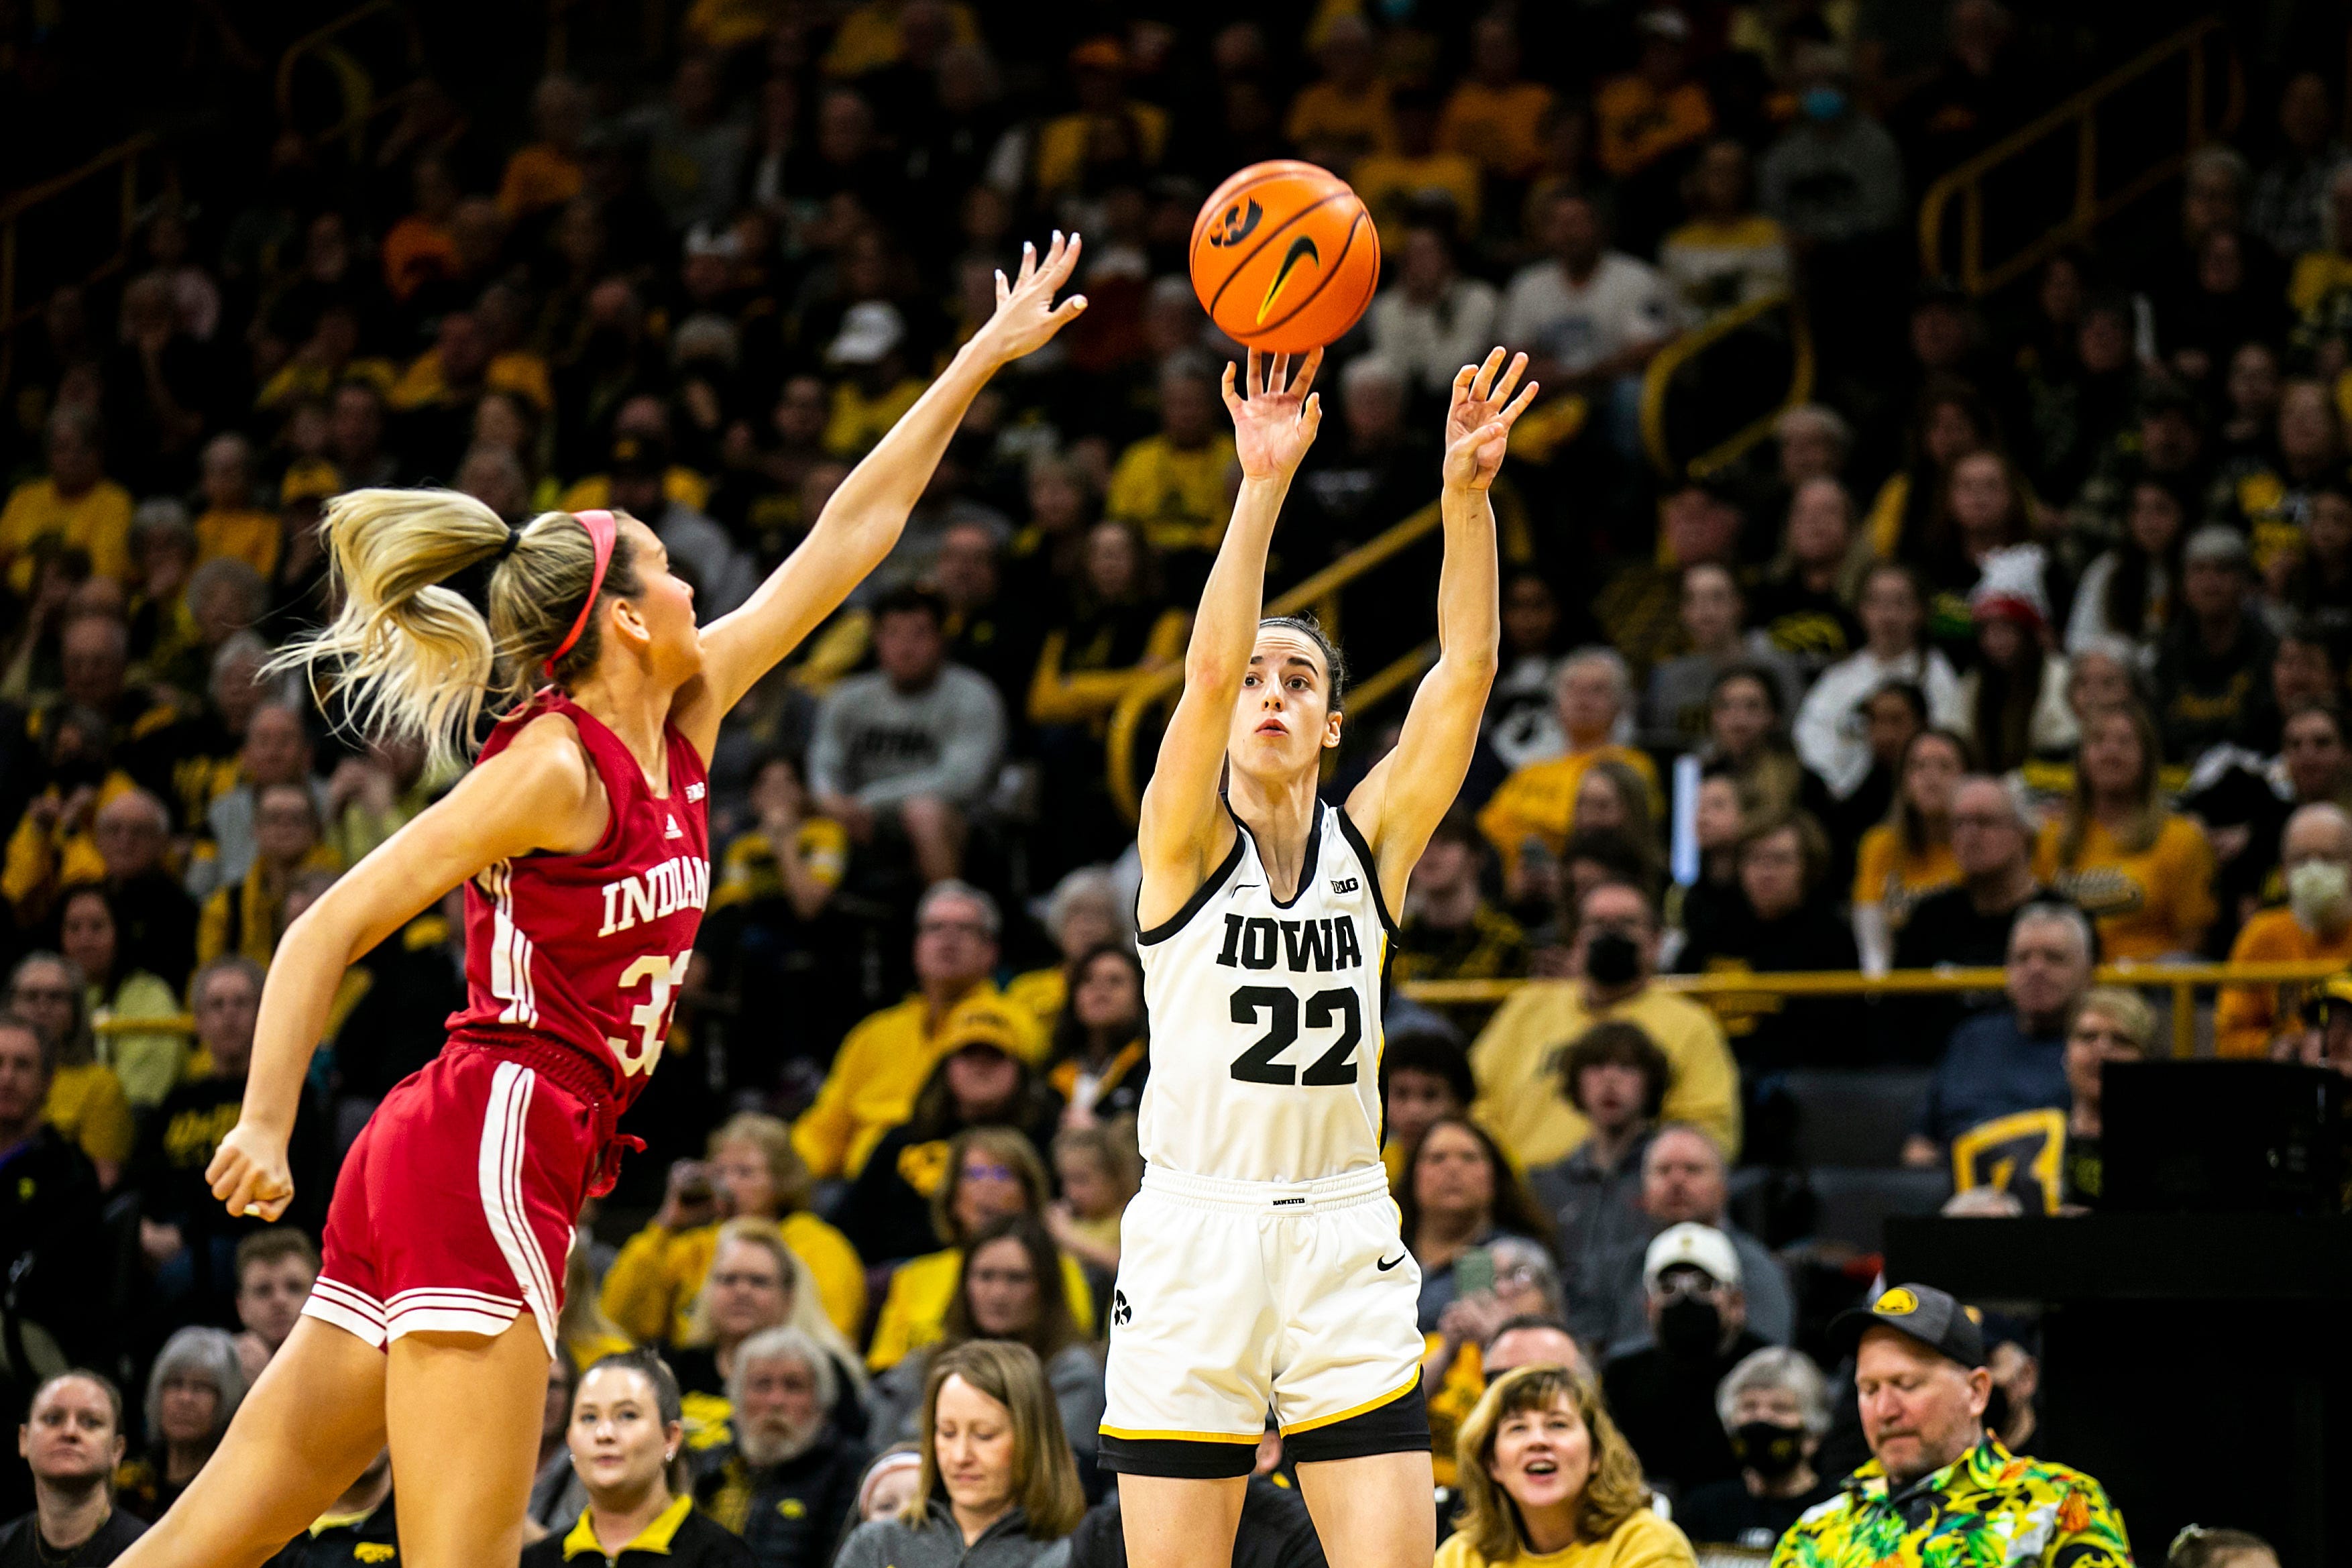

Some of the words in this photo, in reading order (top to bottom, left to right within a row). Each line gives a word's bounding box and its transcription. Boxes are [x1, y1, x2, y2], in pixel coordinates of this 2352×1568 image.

[1216, 913, 1362, 972] IOWA
[1229, 985, 1362, 1086] 22
[1272, 1198, 1305, 1206] HAWKEYES
